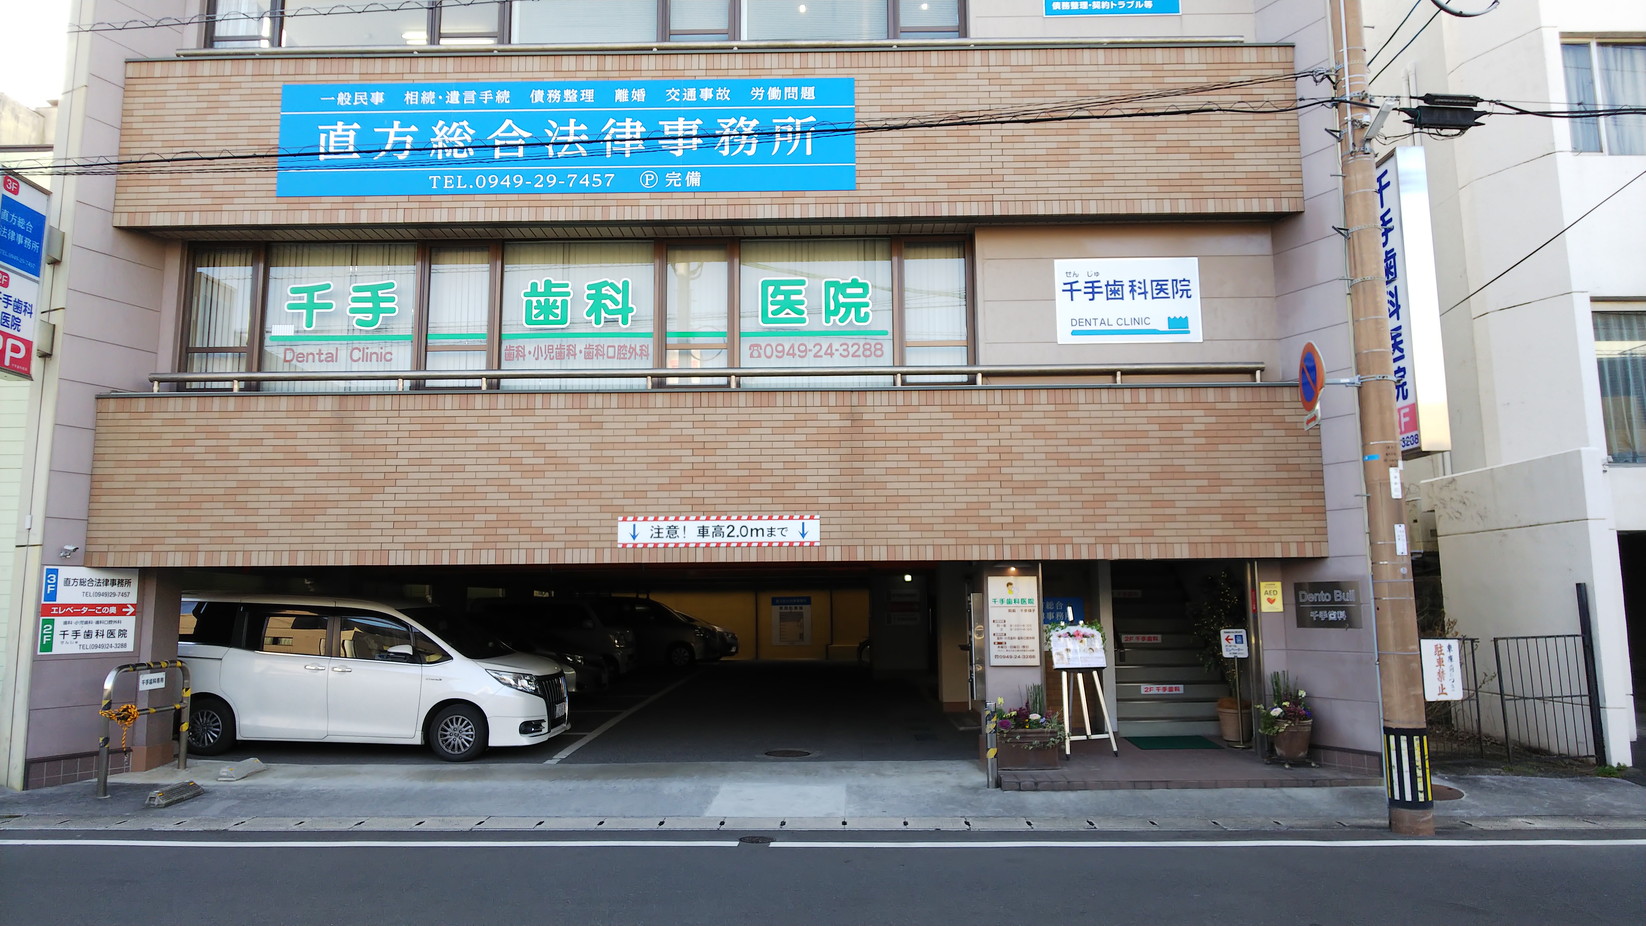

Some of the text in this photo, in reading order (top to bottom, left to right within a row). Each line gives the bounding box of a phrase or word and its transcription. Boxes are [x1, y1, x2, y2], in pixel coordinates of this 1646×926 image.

[320, 85, 816, 106] 一般民事 相続・遺言手続 債務整理 離婚 交通事故 労働問題
[317, 115, 817, 162] 直方総合法律事務所
[6, 178, 18, 191] 3F
[429, 173, 615, 189] TEL.0949-29-7457
[665, 171, 701, 188] 完備
[1, 208, 34, 233] 直方総合
[0, 225, 40, 254] 法律事務所
[1062, 278, 1192, 301] 千手歯科医院
[285, 276, 872, 330] 千手 歯科 医院
[0, 311, 22, 332] 医院
[1070, 316, 1151, 327] DENTAL CLINIC
[283, 347, 393, 364] Dental Clinic
[504, 343, 650, 362] 歯科・小児歯科・歯科口腔外科
[696, 524, 789, 539] 車高2.0mまで
[63, 577, 132, 588] 直方総合法律事務所
[1298, 590, 1332, 602] Dento
[51, 606, 117, 615] エレベーターこの奥
[59, 629, 128, 640] 千手歯科医院
[1433, 643, 1448, 696] 駐車禁止
